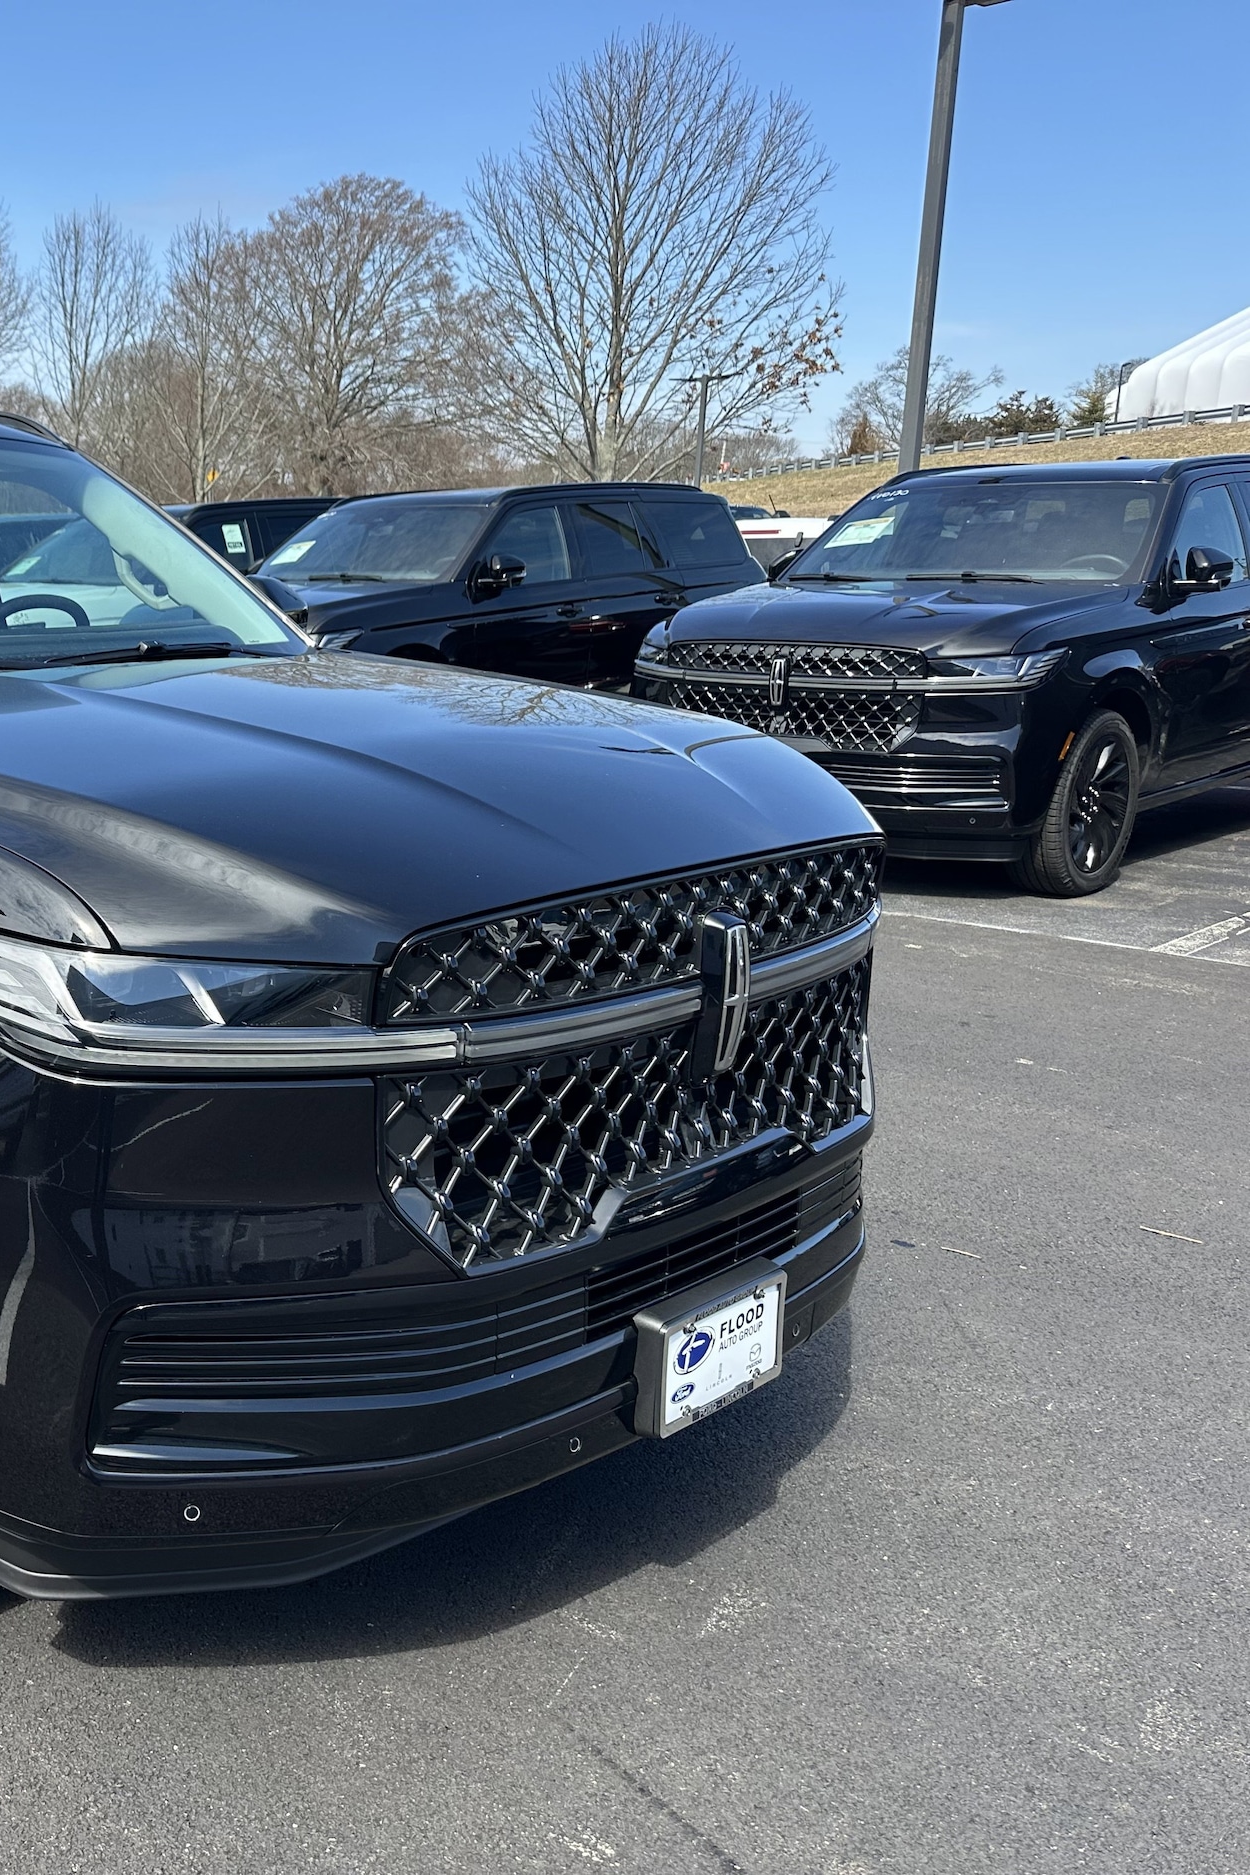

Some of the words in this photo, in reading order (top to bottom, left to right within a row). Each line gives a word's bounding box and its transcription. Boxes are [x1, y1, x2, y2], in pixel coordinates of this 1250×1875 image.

[718, 1336, 738, 1353] AUTO
[738, 1320, 764, 1342] GROUP
[719, 1303, 764, 1339] FLOOD
